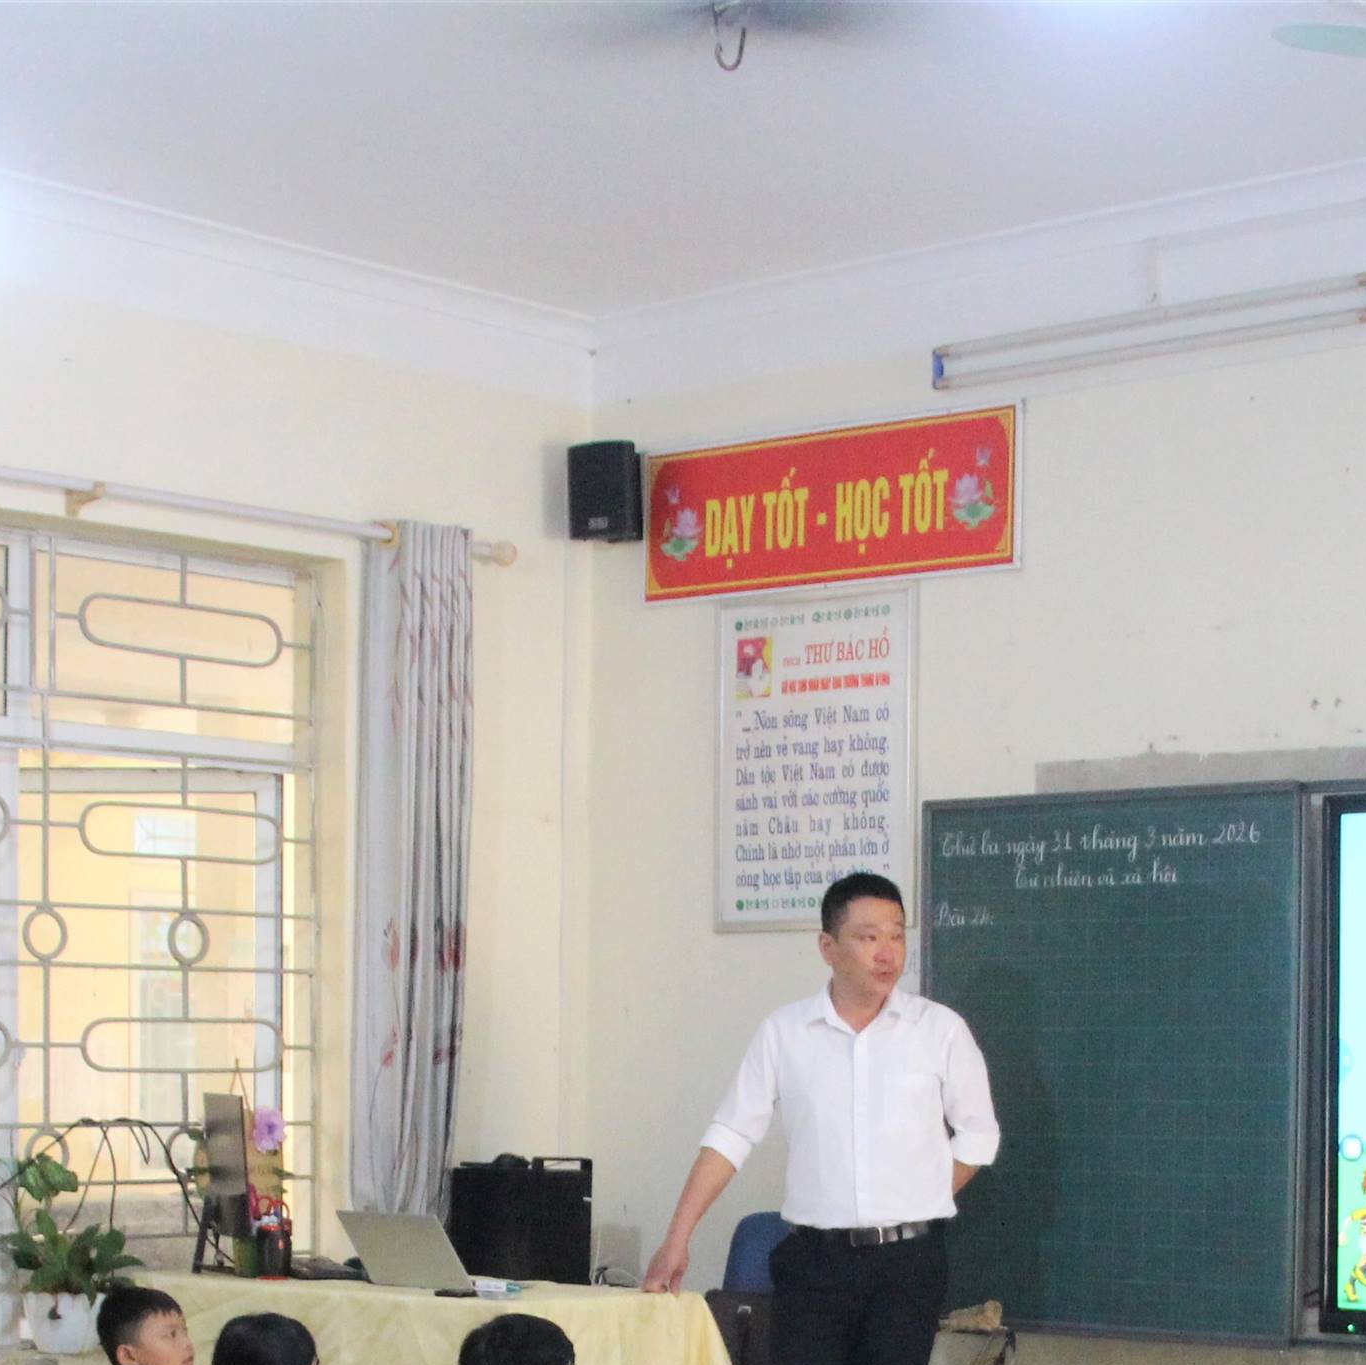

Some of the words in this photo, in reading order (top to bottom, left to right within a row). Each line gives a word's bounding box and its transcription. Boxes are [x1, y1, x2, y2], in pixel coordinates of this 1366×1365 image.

[705, 493, 755, 569] DẠY
[763, 467, 809, 551] TỐT
[835, 477, 891, 555] HỌC
[899, 448, 949, 536] TỐT
[804, 640, 834, 665] THƯ
[836, 633, 865, 662] BÁC
[868, 626, 891, 660] HỒ
[814, 704, 838, 731] Việt
[843, 704, 871, 723] Nam
[876, 700, 890, 721] có
[792, 740, 819, 759] vang
[823, 736, 844, 757] hay
[781, 763, 804, 788] Việt
[809, 762, 836, 781] Nam
[842, 759, 855, 779] có
[762, 791, 778, 810] vai
[809, 814, 832, 836] hay
[768, 841, 779, 861] là
[981, 829, 999, 855] ba
[1006, 834, 1048, 865] ngày
[1053, 829, 1073, 851] 31
[1079, 823, 1139, 862] tháng
[1145, 825, 1156, 848] 3
[1161, 828, 1208, 847] năm
[1212, 821, 1262, 845] 2026
